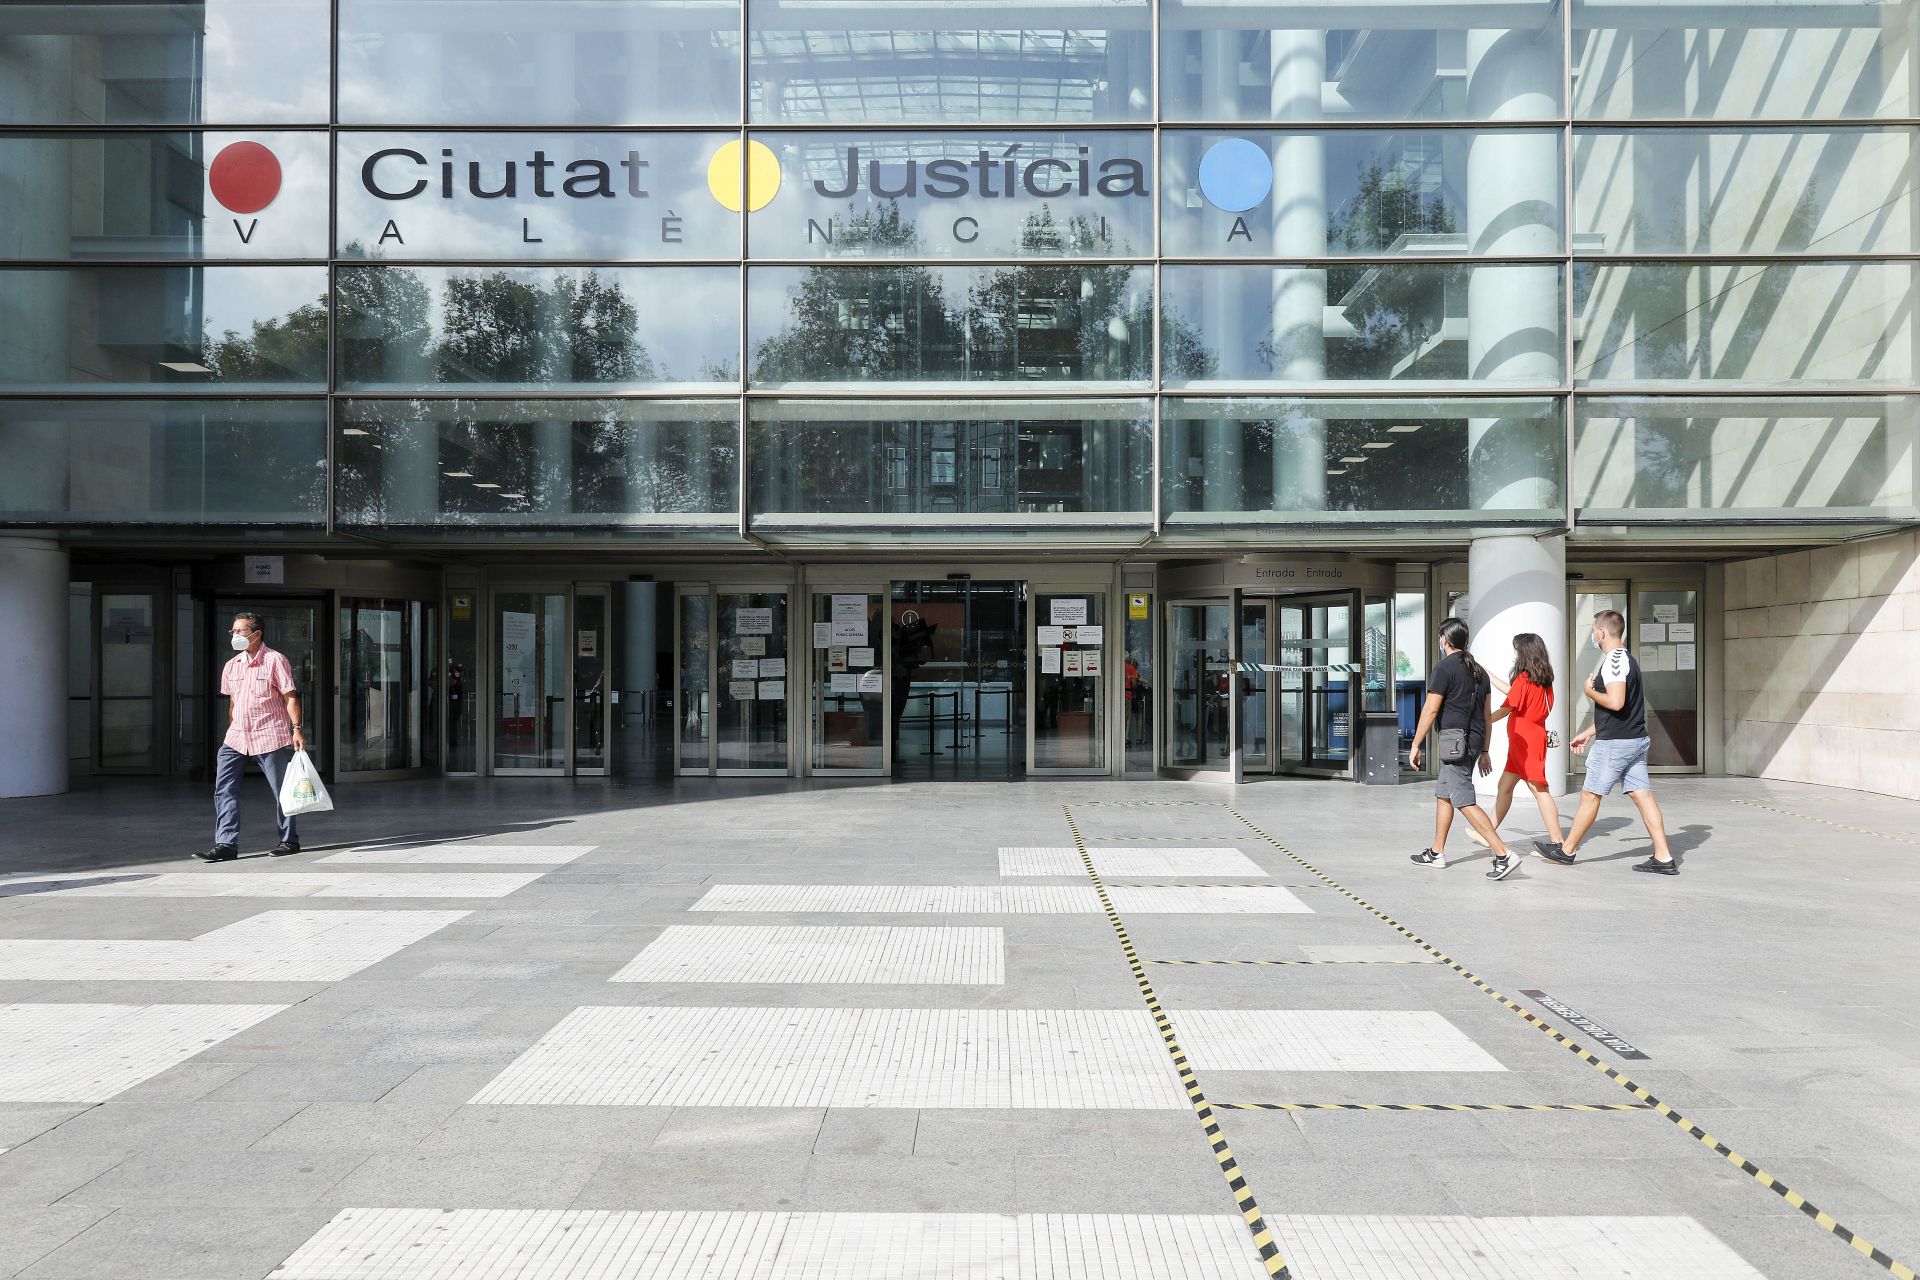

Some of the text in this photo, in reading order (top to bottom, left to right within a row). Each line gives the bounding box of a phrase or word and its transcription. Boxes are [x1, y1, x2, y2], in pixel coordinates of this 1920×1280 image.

[361, 143, 1150, 200] Ciutat Justícia
[1256, 567, 1342, 578] Entrada Entrada
